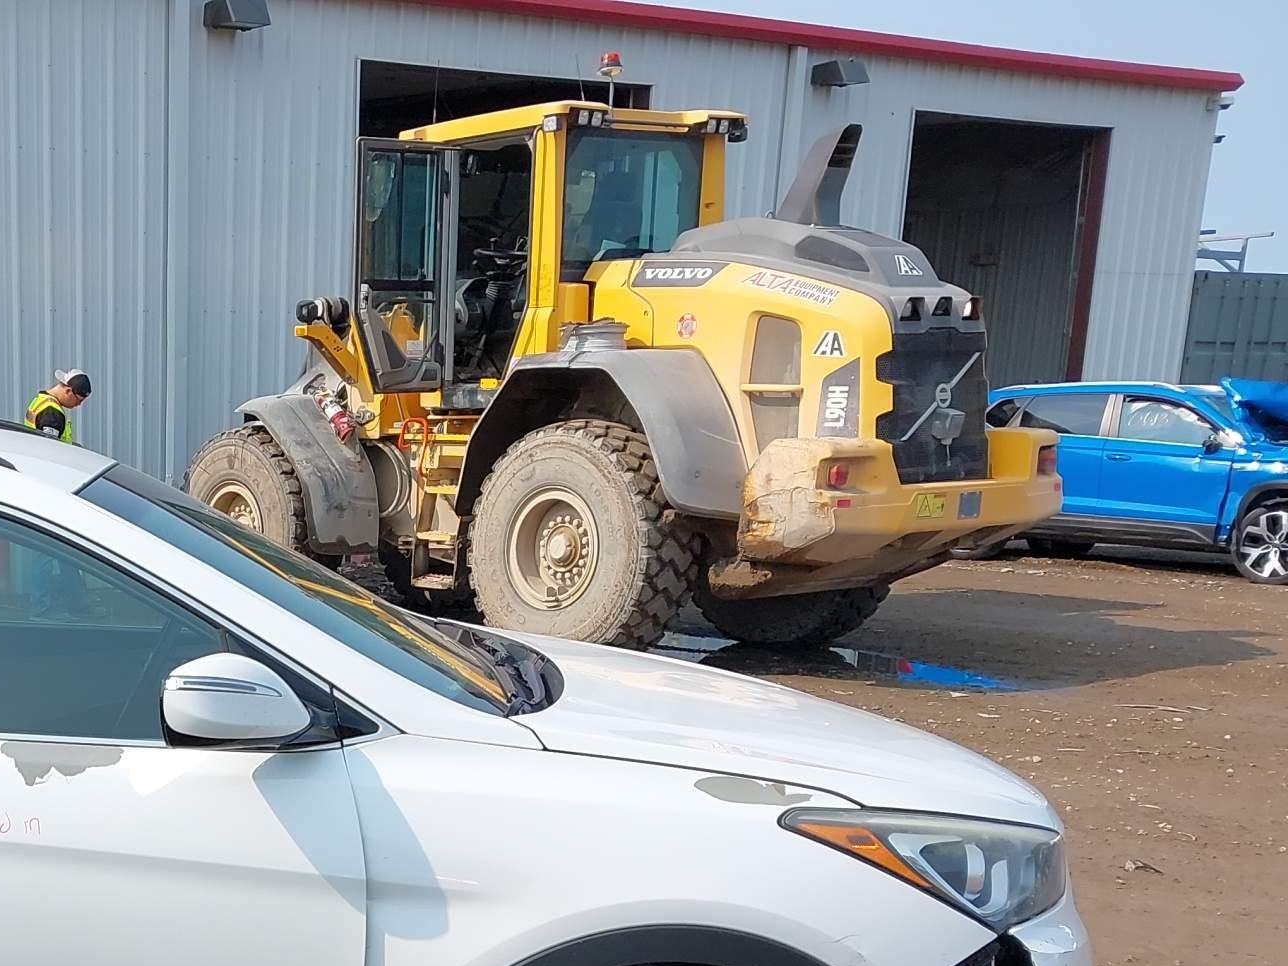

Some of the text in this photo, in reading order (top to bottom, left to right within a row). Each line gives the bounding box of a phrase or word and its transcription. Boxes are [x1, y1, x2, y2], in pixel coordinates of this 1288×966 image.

[644, 267, 712, 279] VOLVO
[741, 271, 793, 293] ALTA
[787, 287, 834, 305] COMPANY
[793, 279, 839, 297] EQUIPMENT
[824, 385, 849, 428] L90H
[24, 818, 41, 834] in
